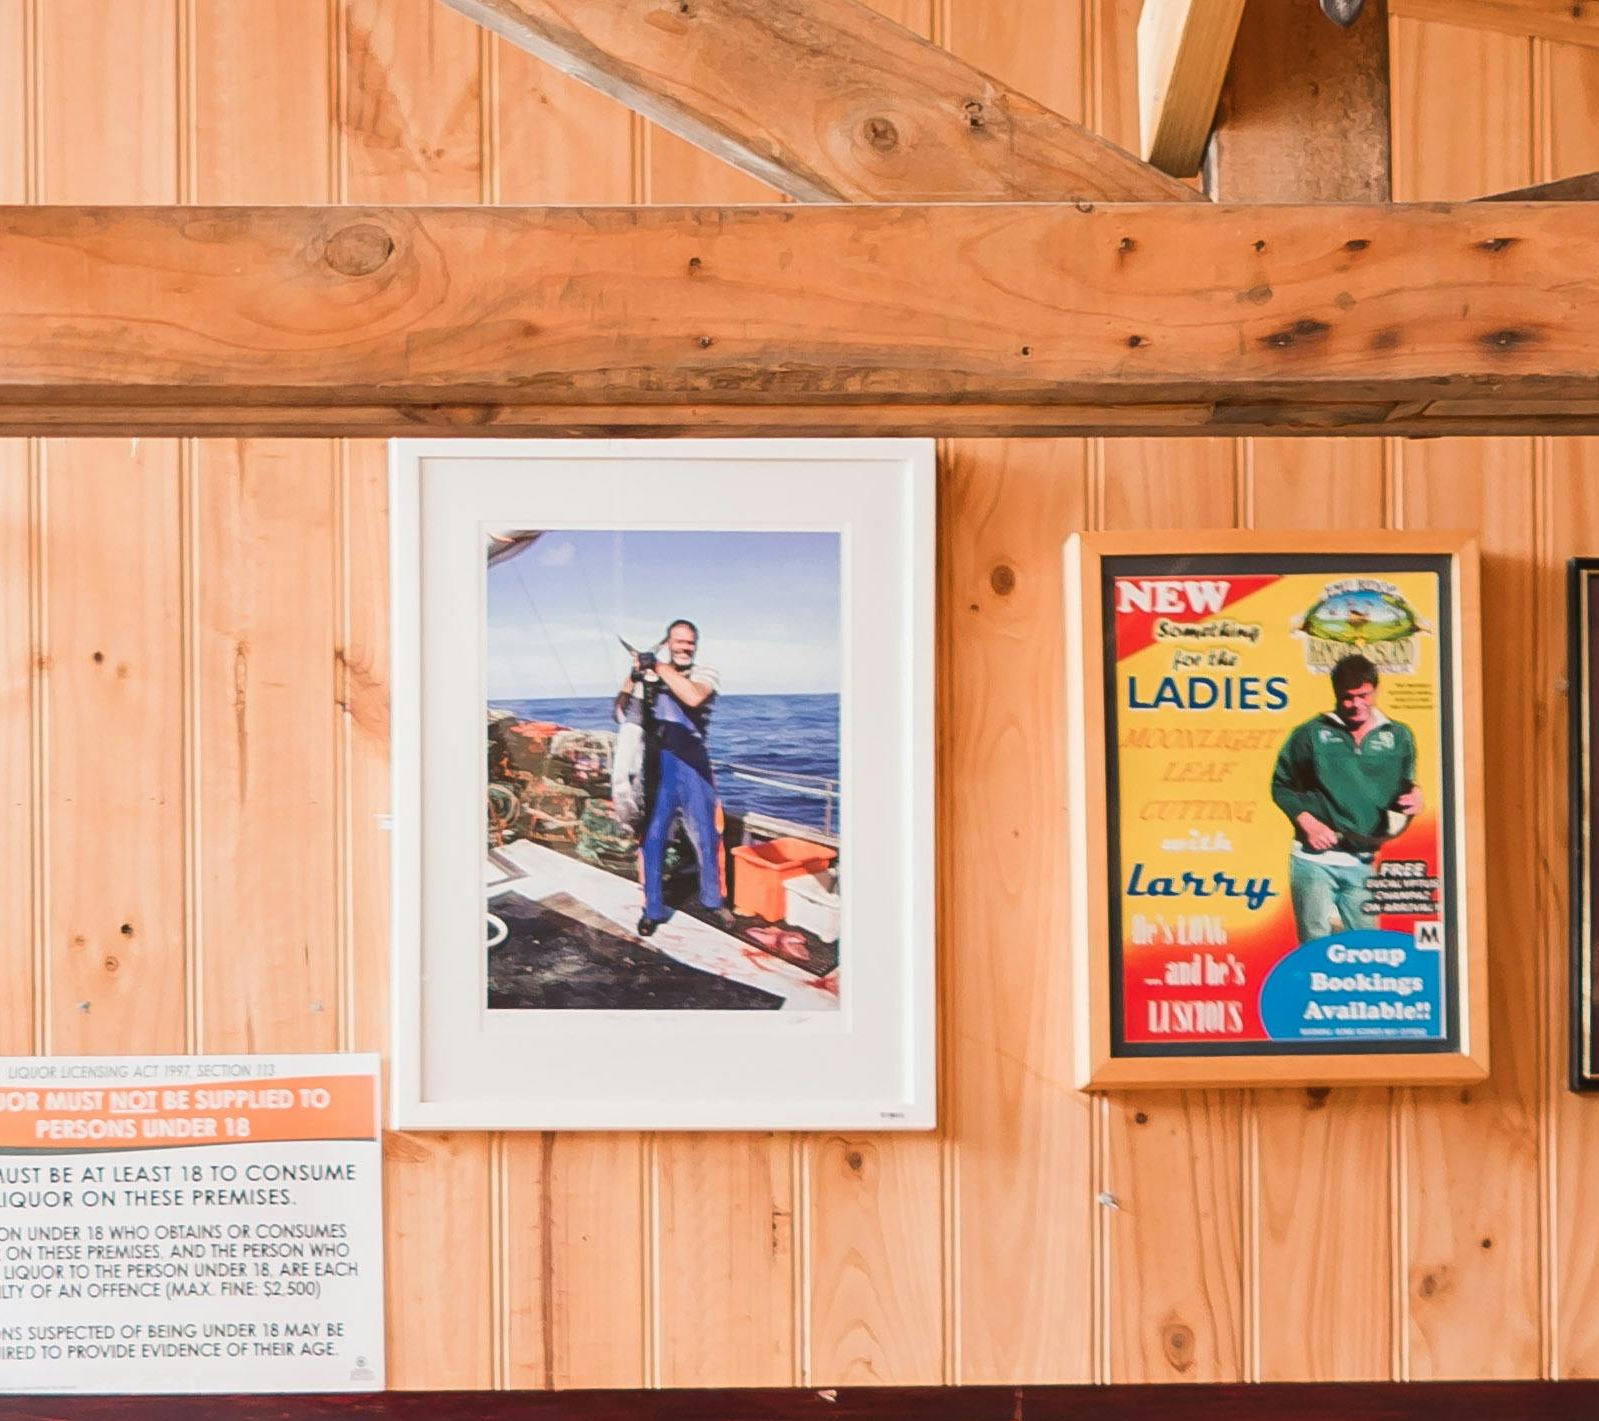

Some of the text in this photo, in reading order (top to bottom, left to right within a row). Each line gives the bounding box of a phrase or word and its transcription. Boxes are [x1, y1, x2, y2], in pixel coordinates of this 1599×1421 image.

[1116, 581, 1231, 614] NEW
[1157, 620, 1261, 645] Something
[1173, 650, 1238, 672] for the
[1128, 676, 1290, 710] LADIES
[1121, 727, 1287, 752] MOONLIGHT
[1162, 761, 1239, 783] LEAF
[1139, 800, 1258, 824] CUTTING
[1161, 828, 1235, 853] with
[1380, 862, 1427, 878] FREE
[1127, 863, 1279, 911] Larry
[1327, 944, 1407, 967] Group
[1310, 972, 1425, 996] Bookings
[1303, 1000, 1432, 1021] Available!!
[46, 1087, 103, 1111] MUST
[110, 1087, 157, 1113] NOT
[163, 1091, 188, 1110] BE
[195, 1089, 293, 1109] SUPPLIED
[301, 1088, 330, 1108] TO
[37, 1118, 249, 1139] PERSONS UNDER 18
[50, 1168, 72, 1183] BE
[81, 1167, 104, 1182] AT
[114, 1166, 171, 1182] LEAST
[182, 1166, 202, 1182] 18
[211, 1165, 239, 1182] TO
[245, 1165, 355, 1181] CONSUME
[82, 1190, 115, 1206] ON
[125, 1190, 183, 1206] THESE
[193, 1189, 295, 1206] PREMISES.
[28, 1227, 80, 1241] UNDER
[88, 1225, 103, 1241] 18
[109, 1226, 149, 1240] WHO
[155, 1224, 222, 1240] OBTAINS
[227, 1224, 250, 1239] OR
[256, 1223, 346, 1239] CONSUMES
[6, 1246, 31, 1261] ON
[38, 1245, 81, 1260] THESE
[171, 1244, 205, 1258] AND
[211, 1243, 236, 1258] THE
[243, 1243, 303, 1257] PERSON
[310, 1243, 349, 1258] WHO
[5, 1264, 63, 1280] LIQUOR
[69, 1264, 89, 1279] TO
[95, 1264, 121, 1278] THE
[128, 1263, 188, 1278] PERSON
[195, 1262, 247, 1277] UNDER
[280, 1262, 308, 1276] ARE
[315, 1262, 357, 1276] EACH
[31, 1284, 51, 1299] OF
[58, 1284, 81, 1298] AN
[87, 1283, 160, 1297] OFFENCE
[29, 1325, 115, 1340] SUSPECTED
[121, 1325, 141, 1339] OF
[148, 1324, 197, 1338] BEING
[203, 1323, 256, 1338] UNDER
[263, 1323, 279, 1337] 18
[284, 1324, 320, 1337] MAY
[327, 1323, 343, 1337] BE
[42, 1346, 61, 1359] TO
[68, 1344, 135, 1359] PROVIDE
[142, 1342, 220, 1358] EVIDENCE
[227, 1342, 247, 1356] OF
[253, 1342, 294, 1356] THEIR
[301, 1342, 338, 1357] AGE.
